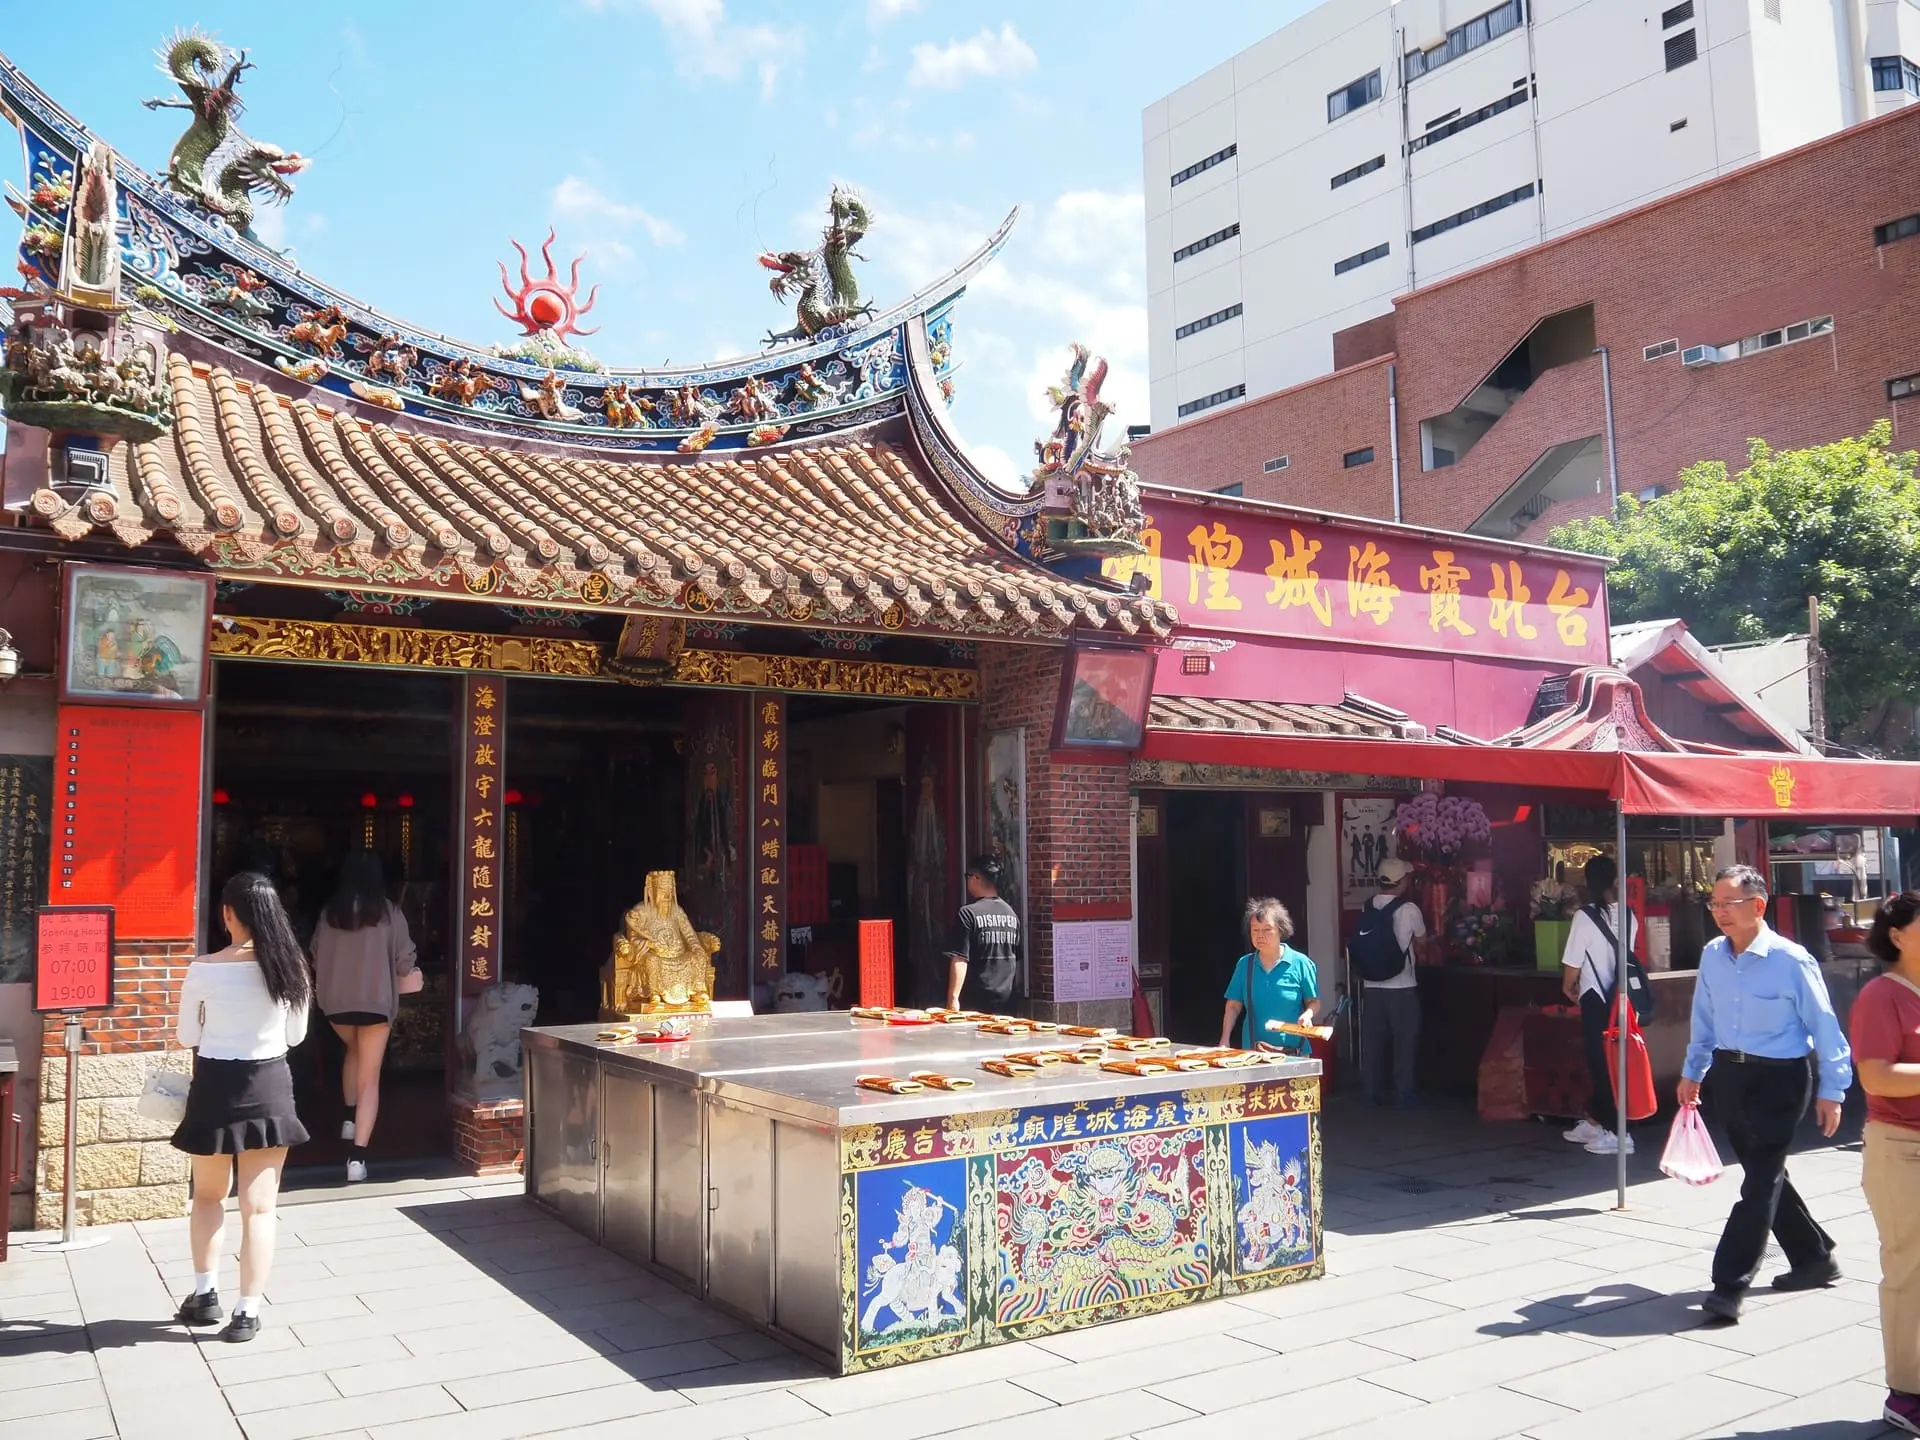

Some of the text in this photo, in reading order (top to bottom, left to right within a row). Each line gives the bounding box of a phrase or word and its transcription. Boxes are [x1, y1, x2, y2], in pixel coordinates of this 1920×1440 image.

[41, 928, 79, 938] Opening
[51, 959, 97, 975] 07:00
[51, 985, 96, 1001] 19:00
[1019, 1100, 1180, 1144] 霞海城隍廟
